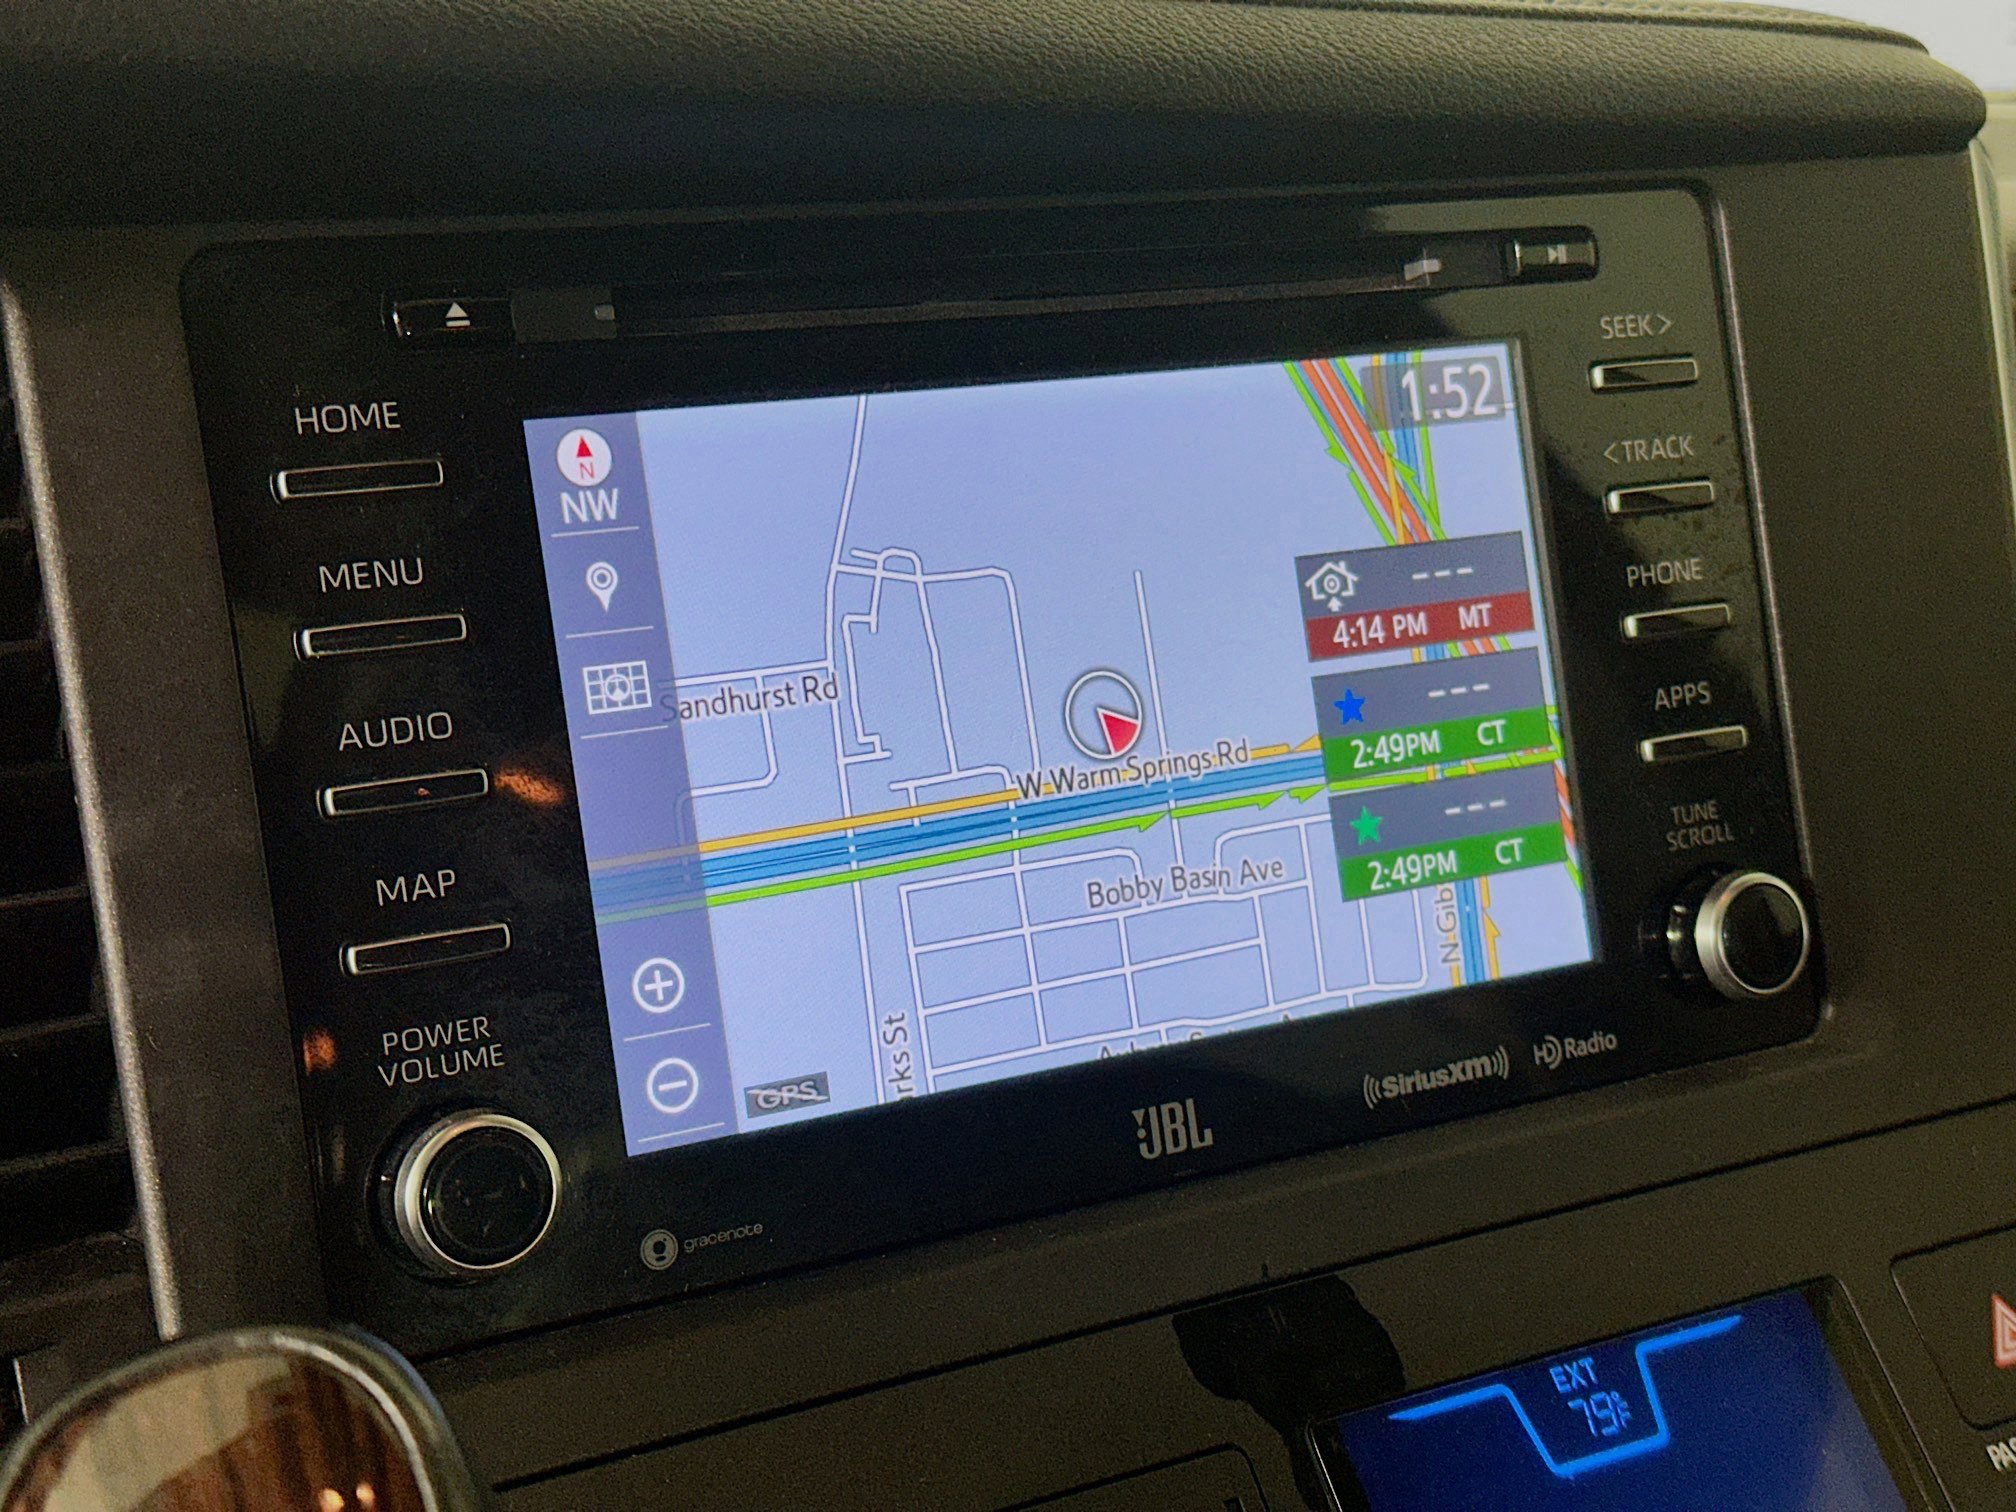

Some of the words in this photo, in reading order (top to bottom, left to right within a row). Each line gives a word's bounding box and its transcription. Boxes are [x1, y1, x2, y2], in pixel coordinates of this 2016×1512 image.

[1600, 314, 1654, 339] SEEK
[1401, 364, 1498, 421] 1:52
[294, 401, 402, 435] HOME
[1621, 435, 1694, 462] TRACK
[579, 461, 596, 479] N
[559, 488, 619, 524] NW
[318, 557, 424, 593] MENU
[1626, 558, 1703, 587] PHONE
[1332, 614, 1386, 649] 4:14
[1393, 611, 1428, 639] PM
[1458, 603, 1493, 630] MT
[660, 682, 796, 722] Sandhurst
[802, 673, 839, 703] Rd
[1654, 681, 1713, 711] APPS
[338, 711, 454, 751] AUDIO
[1350, 729, 1441, 769] 2:49PM
[1477, 719, 1507, 746] CT
[1017, 772, 1042, 799] W
[1050, 766, 1123, 794] Warm
[1126, 751, 1213, 781] Springs
[1216, 738, 1249, 765] Rd
[1670, 800, 1720, 826] TUNE
[1666, 823, 1735, 851] SCROLL
[1367, 849, 1459, 891] 2:49PM
[1494, 838, 1524, 865] CT
[375, 868, 456, 907] MAP
[1087, 874, 1163, 908] Bobby
[1170, 864, 1231, 892] Basin
[1239, 858, 1284, 886] Ave
[1434, 884, 1457, 933] Gib
[1440, 942, 1461, 964] N
[382, 1015, 492, 1056] POWER
[882, 1012, 908, 1046] St
[1564, 1032, 1618, 1058] Radio
[377, 1043, 506, 1088] VOLUME
[889, 1049, 914, 1098] rks
[756, 1080, 819, 1109] GPS
[1137, 1098, 1214, 1160] JBL
[683, 1223, 764, 1253] gracenote
[1549, 1357, 1598, 1393] EXT
